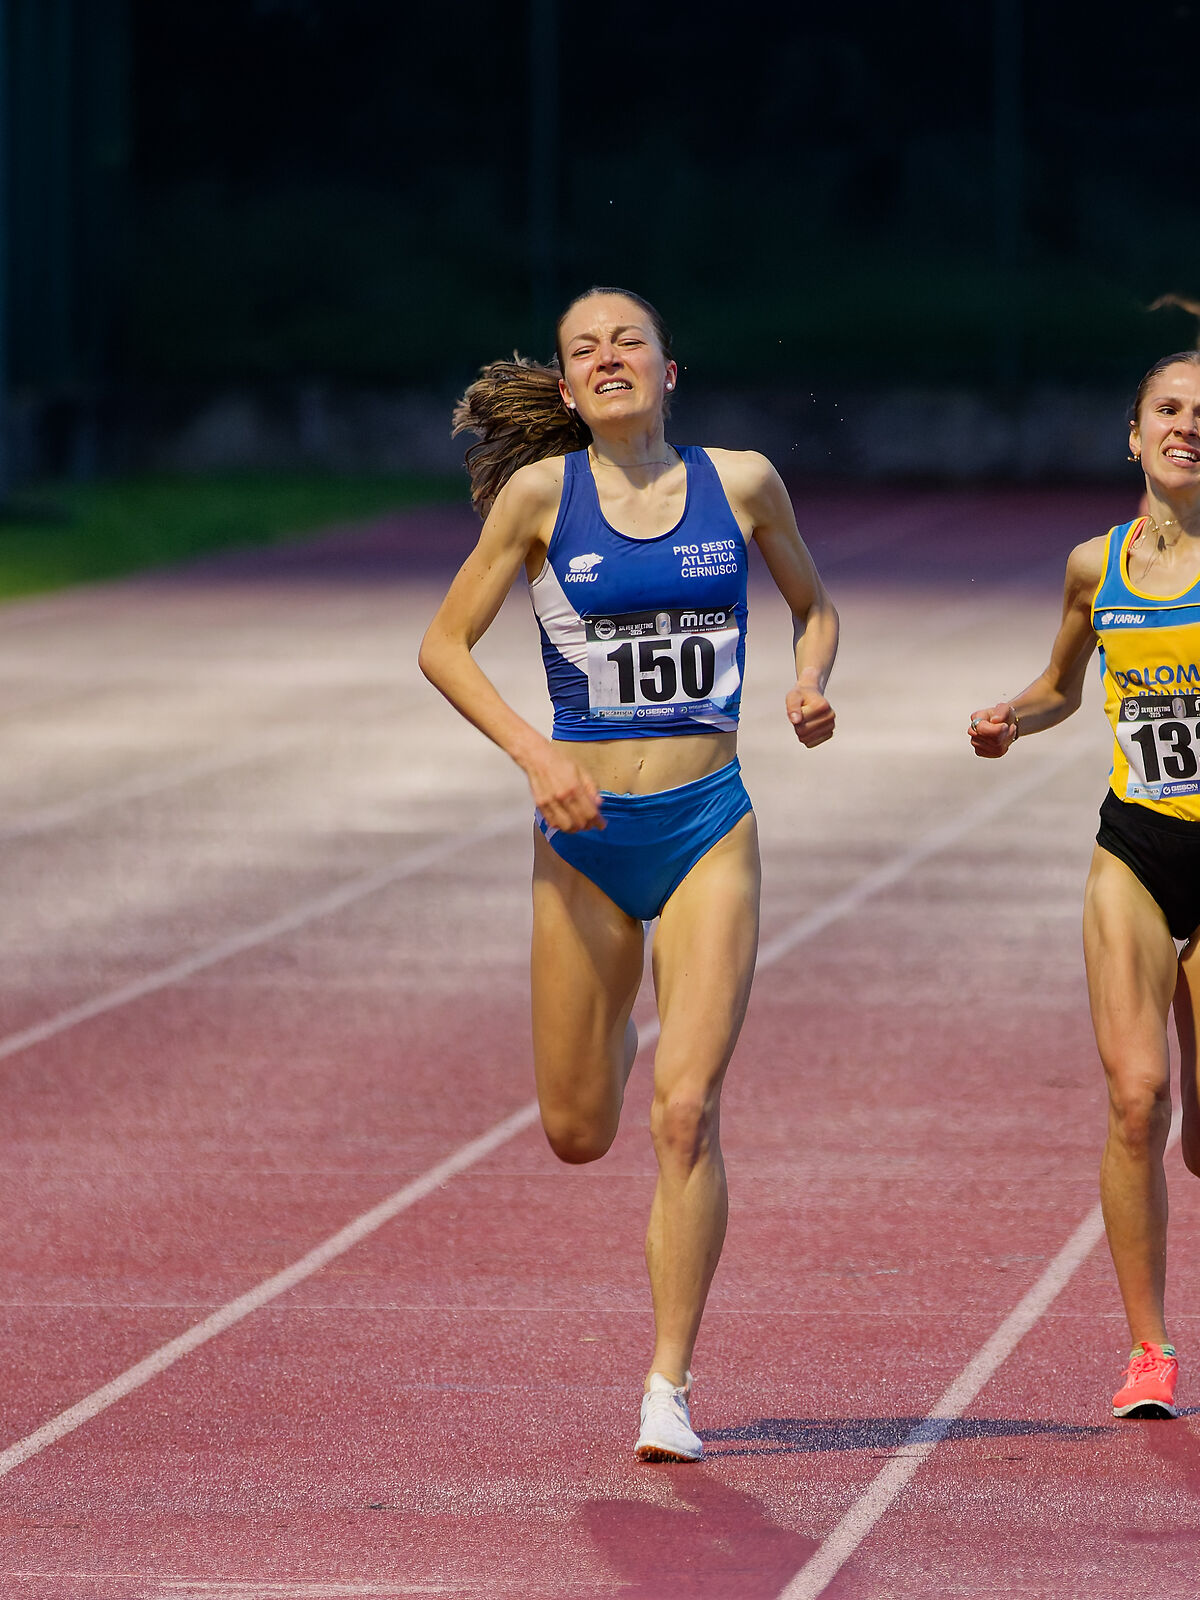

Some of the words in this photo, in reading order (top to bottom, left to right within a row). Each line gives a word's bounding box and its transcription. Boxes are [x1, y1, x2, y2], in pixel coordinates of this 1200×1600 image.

[673, 545, 699, 555] PRO
[701, 539, 736, 552] SESTO
[681, 552, 736, 567] ATLETICA
[564, 573, 599, 583] KARHU
[681, 563, 738, 578] CERNUSCO
[680, 611, 726, 627] mico
[1113, 613, 1146, 625] KARHU
[607, 636, 715, 703] 150
